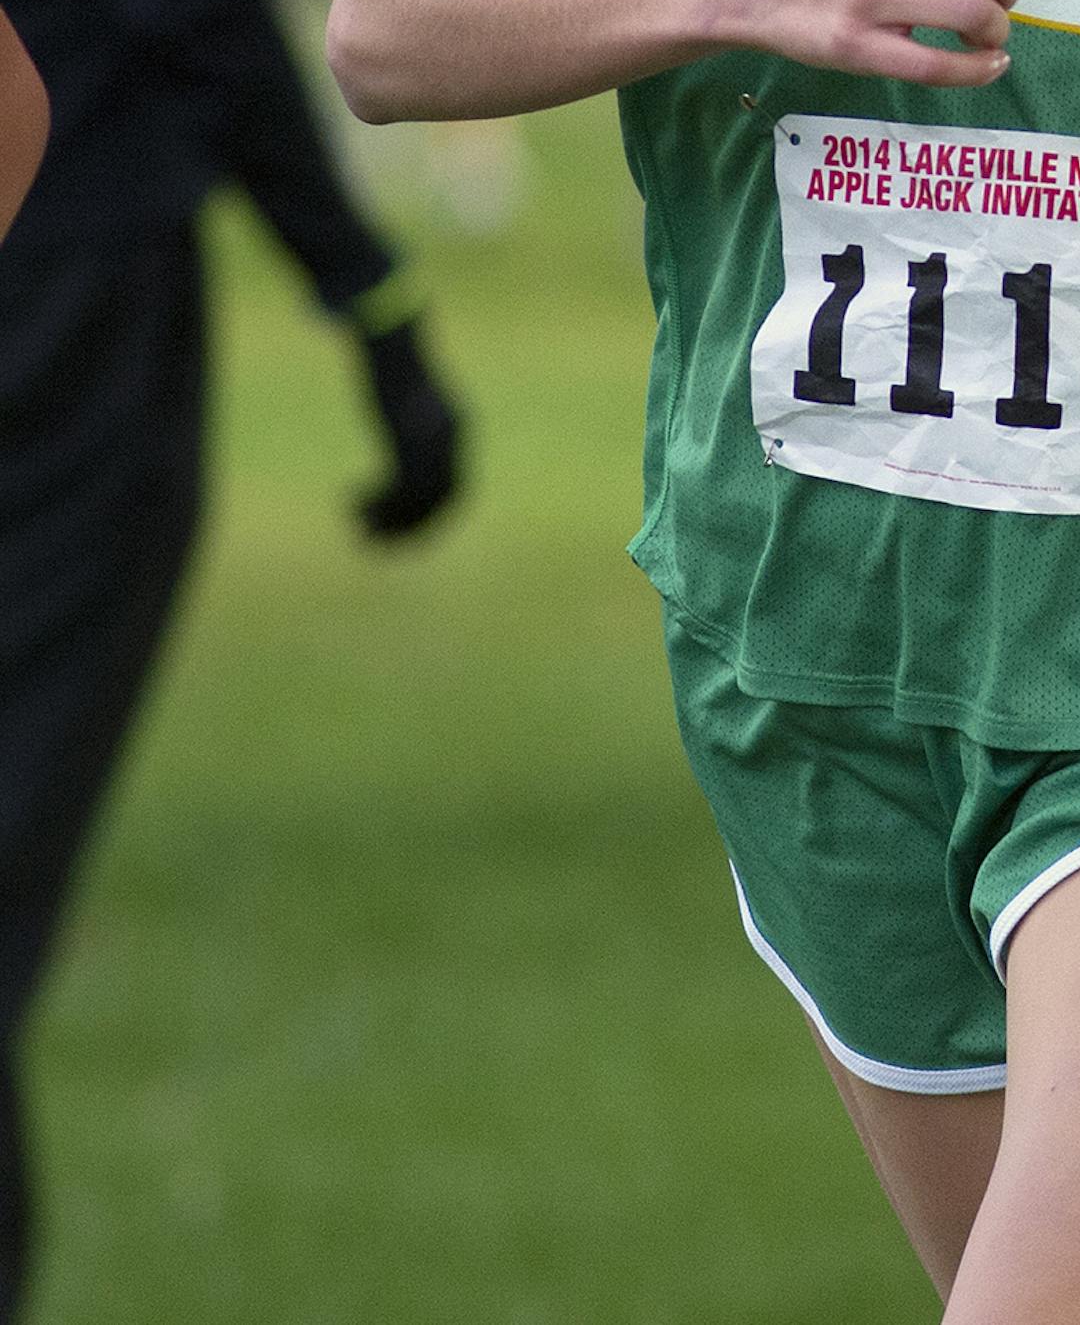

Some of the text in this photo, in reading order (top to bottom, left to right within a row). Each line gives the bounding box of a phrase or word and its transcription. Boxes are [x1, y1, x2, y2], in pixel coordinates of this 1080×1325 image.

[823, 135, 890, 170] 2014
[900, 142, 1058, 183] LAKEVILLE
[807, 169, 891, 206] APPLE
[900, 179, 972, 213] JACK
